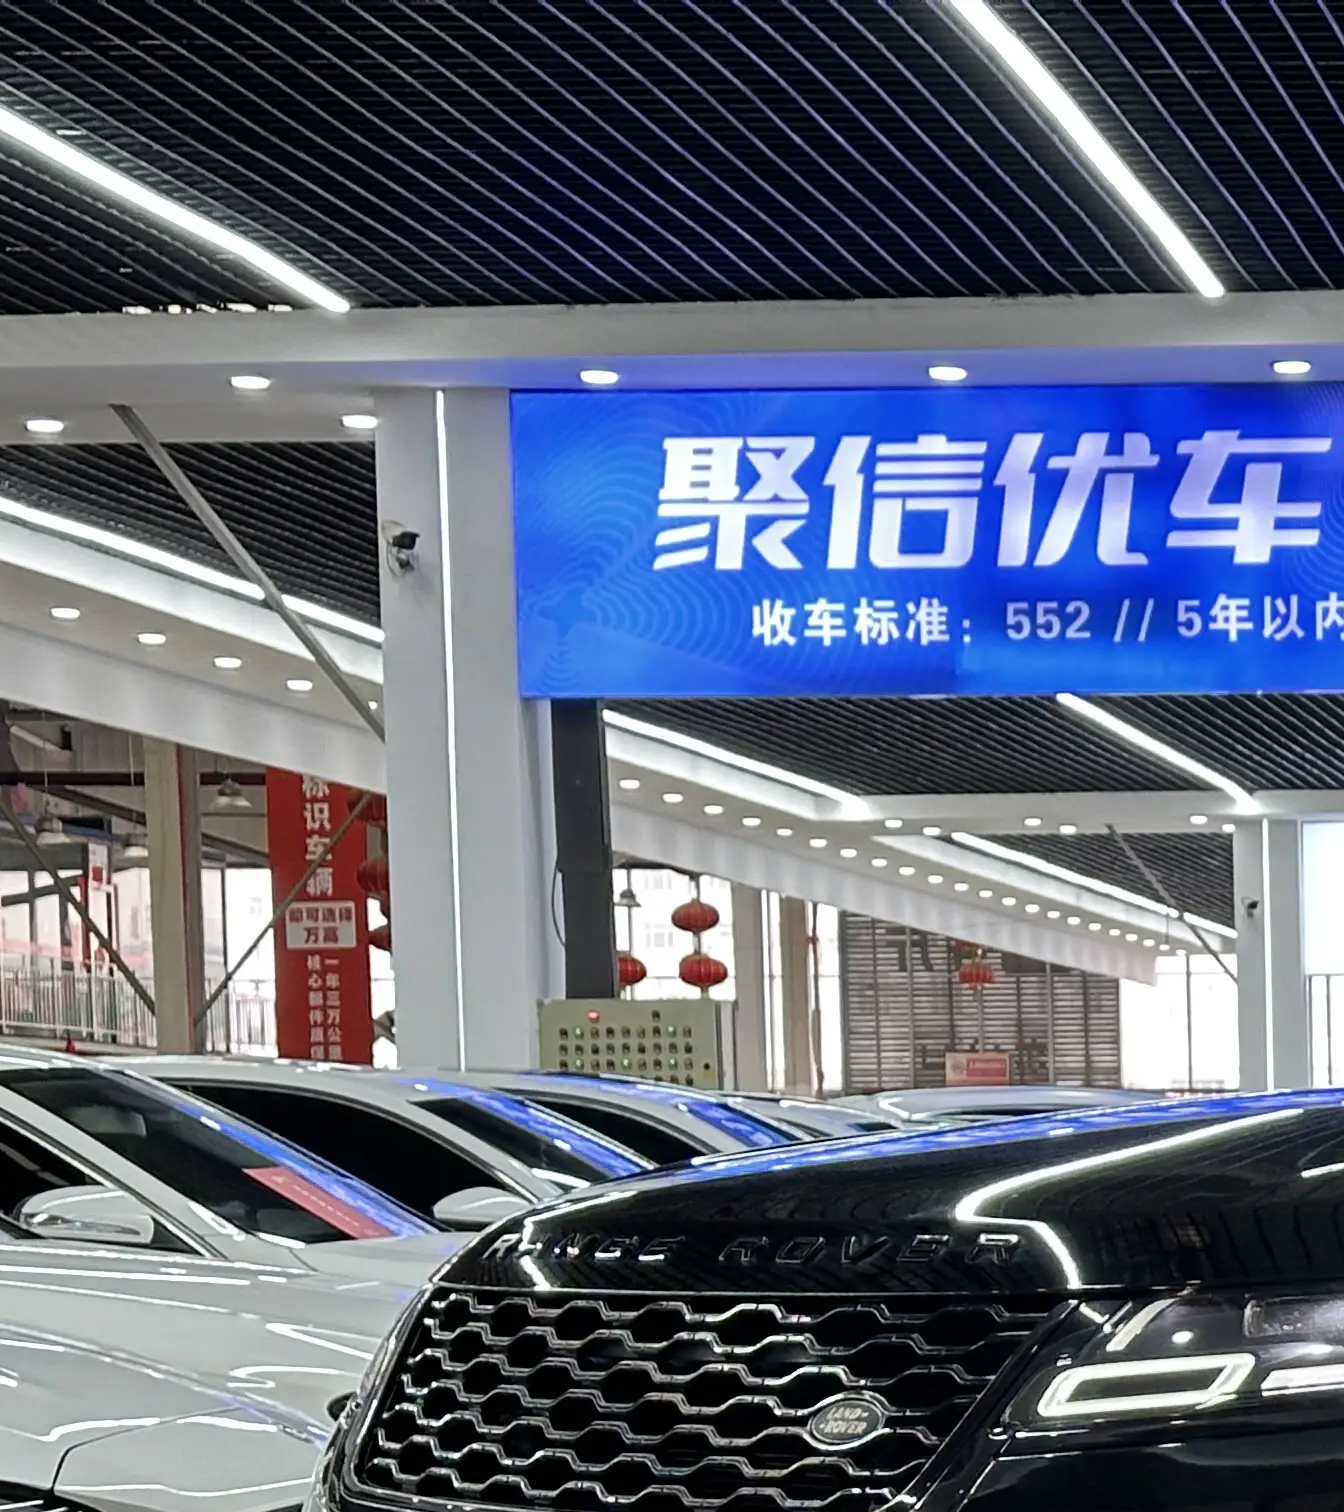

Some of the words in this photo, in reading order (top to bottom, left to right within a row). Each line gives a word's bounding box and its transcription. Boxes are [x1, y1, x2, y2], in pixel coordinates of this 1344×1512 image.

[652, 430, 1332, 571] 聚信优车
[1005, 598, 1093, 642] 552
[716, 1232, 1020, 1265] ROVER
[823, 1419, 868, 1435] ROVER
[825, 1406, 863, 1421] LAND
